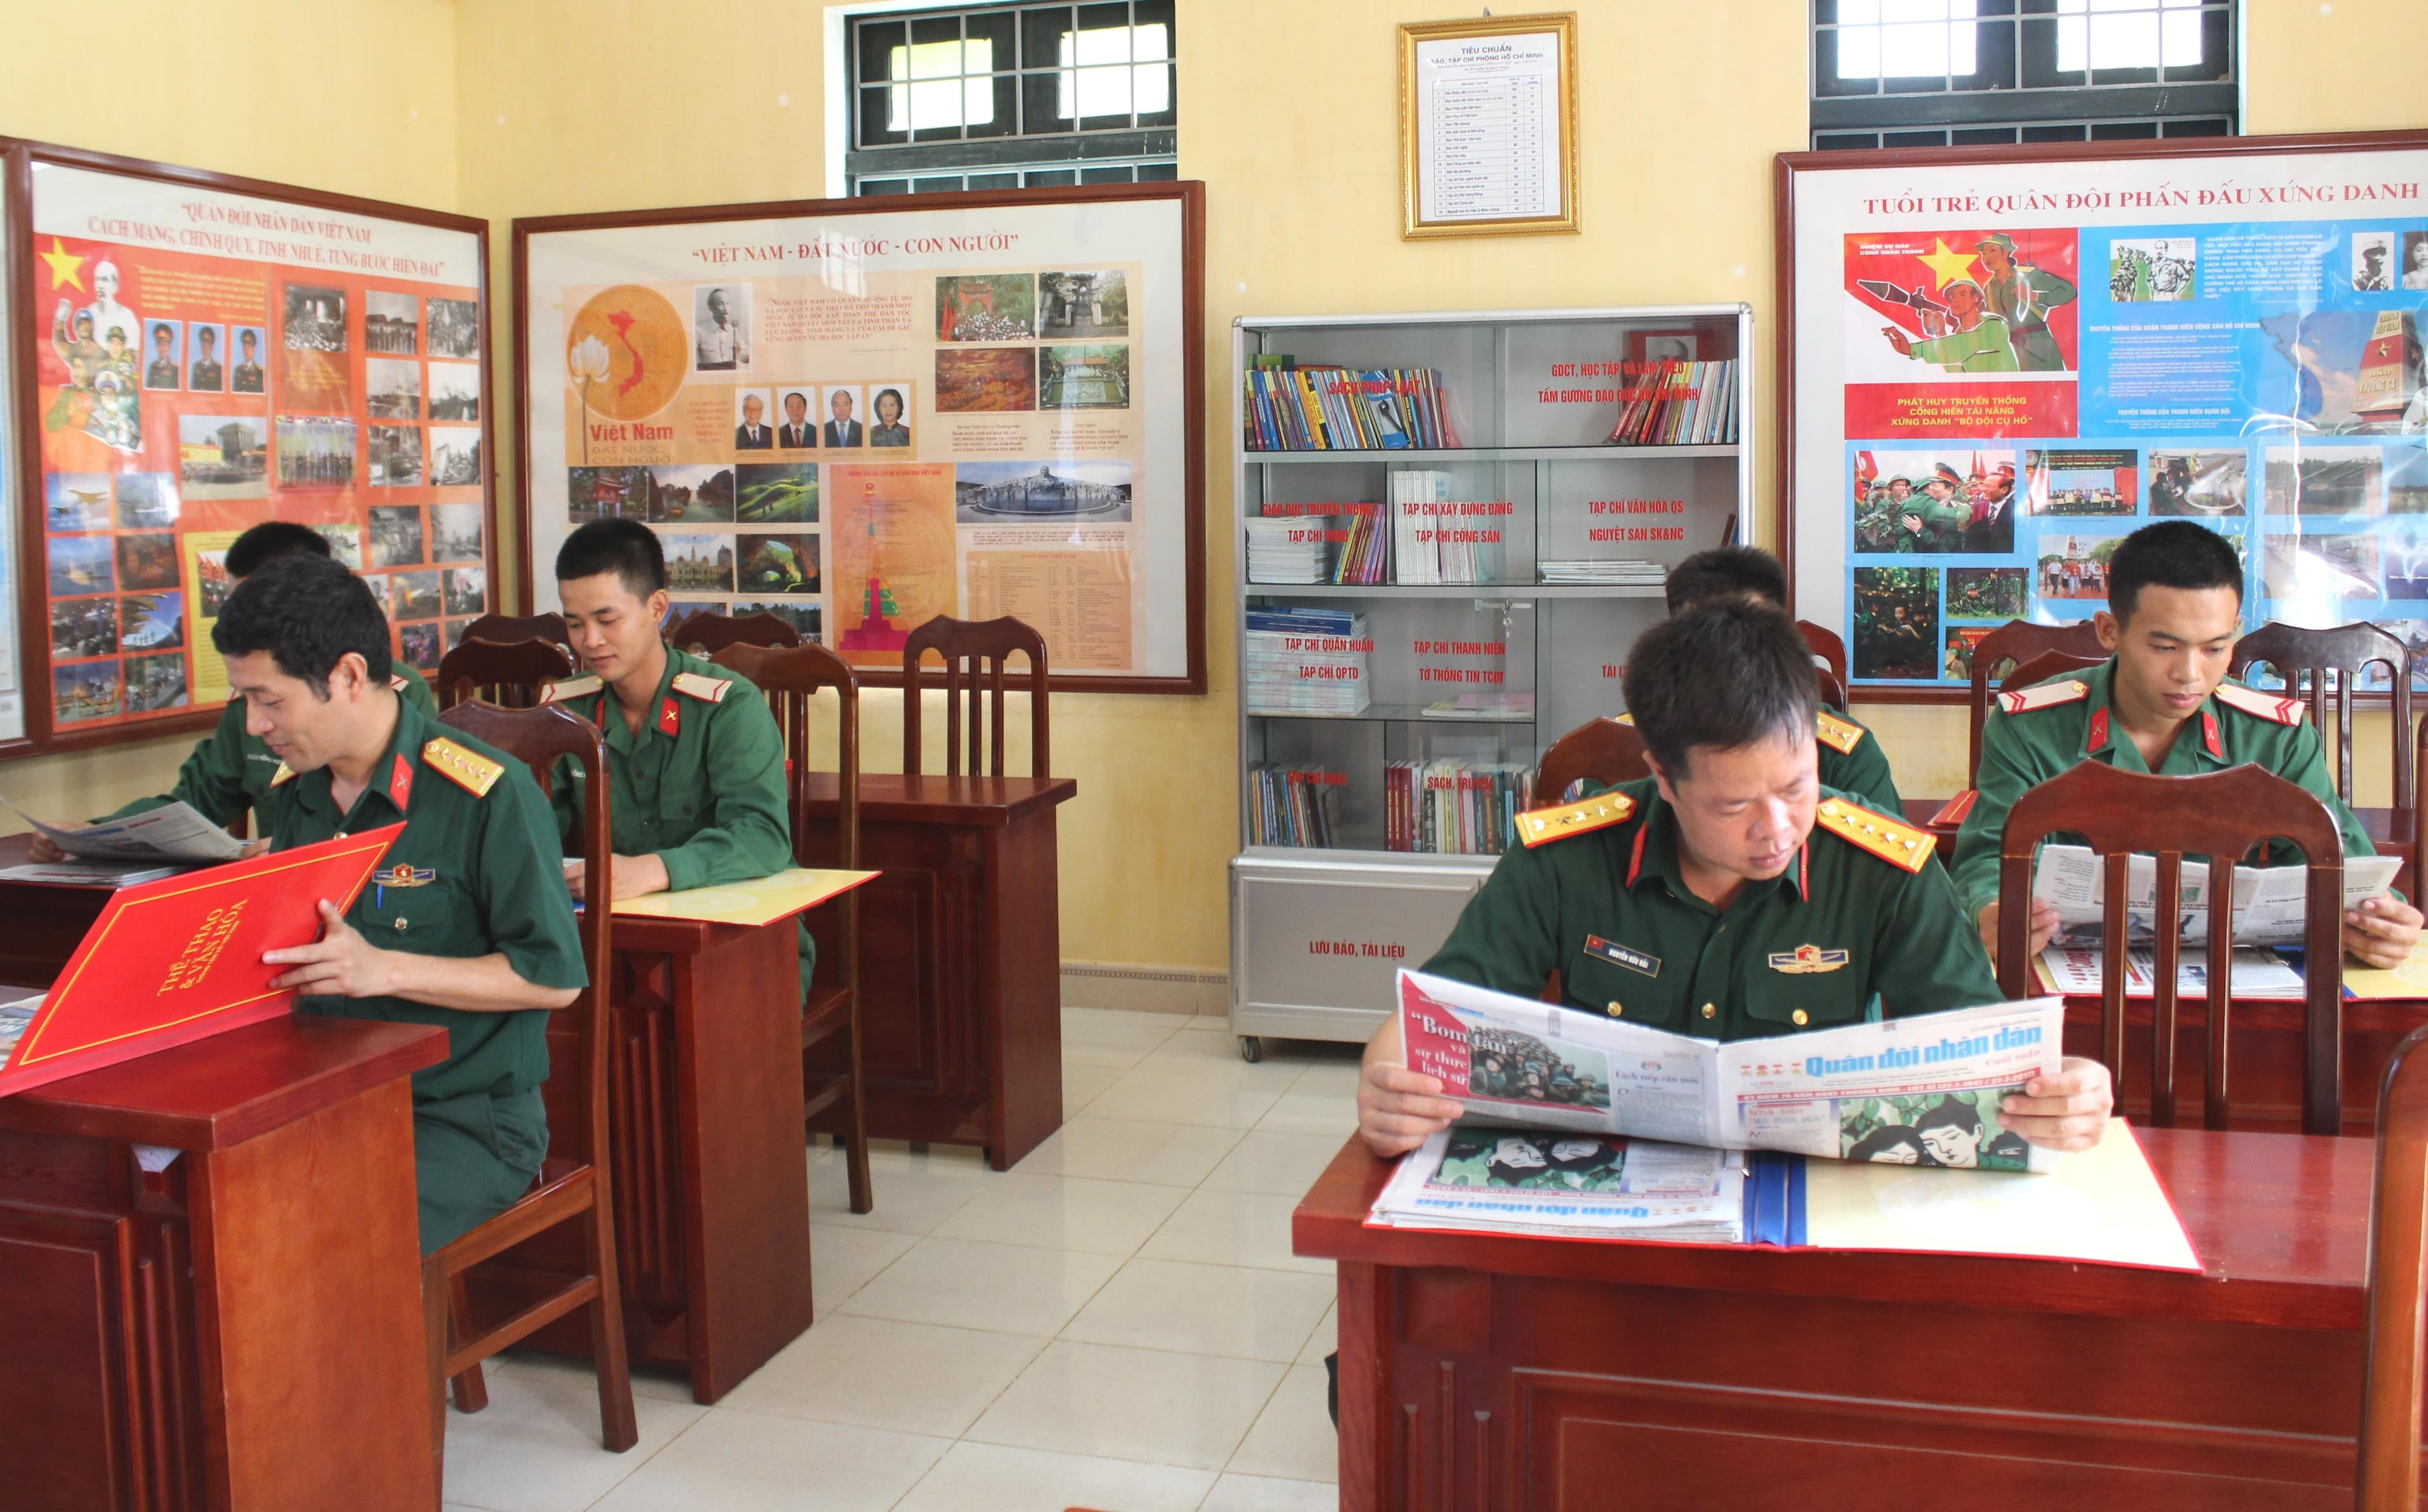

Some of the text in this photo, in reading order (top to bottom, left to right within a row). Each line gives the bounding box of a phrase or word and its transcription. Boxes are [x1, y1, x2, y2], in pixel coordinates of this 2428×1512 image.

[1461, 42, 1512, 54] TIÊU CHUẨN
[1863, 179, 2420, 214] TUỔI TRẺ QUÂN ĐỘI PHẤN ĐẤU XỨNG DANH
[228, 205, 251, 226] ĐỘI
[254, 210, 287, 231] NHÂN
[291, 215, 314, 235] DÂN
[317, 220, 343, 241] VIỆT
[346, 226, 371, 243] NAM
[88, 212, 128, 237] CÁCH
[180, 226, 221, 250] CHÍNH
[256, 239, 286, 257] TINH
[329, 245, 358, 267] TỪNG
[361, 250, 390, 271] BƯỚC
[393, 254, 417, 274] HIỆN
[744, 245, 783, 261] NAM
[797, 236, 833, 259] ĐẤT
[839, 233, 890, 257] NƯỚC
[905, 238, 944, 255] CON
[1552, 359, 1684, 379] GDCT, HỌC TẬP VÀ LÀM THEO
[1330, 377, 1420, 396] SÁCH PHÁP LUẬT
[1538, 386, 1558, 403] TẤM
[1561, 389, 1592, 403] GƯƠNG
[1595, 389, 1614, 405] ĐẠO
[1617, 385, 1636, 402] ĐỨC
[1674, 388, 1699, 401] MINH
[1897, 397, 1923, 406] PHÁT
[1992, 394, 2027, 405] THỐNG
[1910, 406, 2014, 416] CỐNG HIẾN TÀI NĂNG
[1891, 417, 1920, 426] XỨNG
[1996, 417, 2010, 426] CỤ
[589, 424, 673, 444] Việt Nam
[1286, 503, 1303, 518] DỤC
[1306, 501, 1340, 516] TRUYỀN
[1402, 498, 1512, 518] TẠP CHÍ XÂY DỰNG ĐẢNG
[1589, 497, 1684, 516] TẠP CHÍ VĂN HÓA QS
[1288, 527, 1322, 544] TẠP CHÍ
[1415, 525, 1500, 546] TẠP CHÍ CỘNG SẢN
[1589, 525, 1684, 544] NGUYỆT SAN SK&NC
[1285, 635, 1374, 653] TẠP CHÍ QUÂN HUẤN
[1414, 638, 1505, 656] TẠP CHÍ THANH NIÊN
[1299, 664, 1359, 681] TẠP CHÍ QPTD
[1419, 665, 1431, 681] TỜ
[1433, 667, 1462, 682] THÔNG
[1465, 670, 1480, 683] TIN
[1602, 662, 1616, 678] TÀI
[1428, 774, 1455, 790] SÁCH,
[187, 940, 220, 976] VĂN
[212, 899, 248, 938] HÓA
[157, 959, 190, 997] THỂ
[181, 908, 223, 958] THAO
[1309, 939, 1405, 961] LƯU BÁO, TÀI LIỆU
[1414, 1048, 1468, 1070] sự thực
[1450, 1043, 1466, 1056] và
[1806, 1054, 1874, 1078] Quân
[1879, 1045, 1920, 1070] đội
[1923, 1035, 1989, 1063] nhân
[1993, 1025, 2042, 1051] dân
[1422, 1061, 1468, 1086] lịch sử
